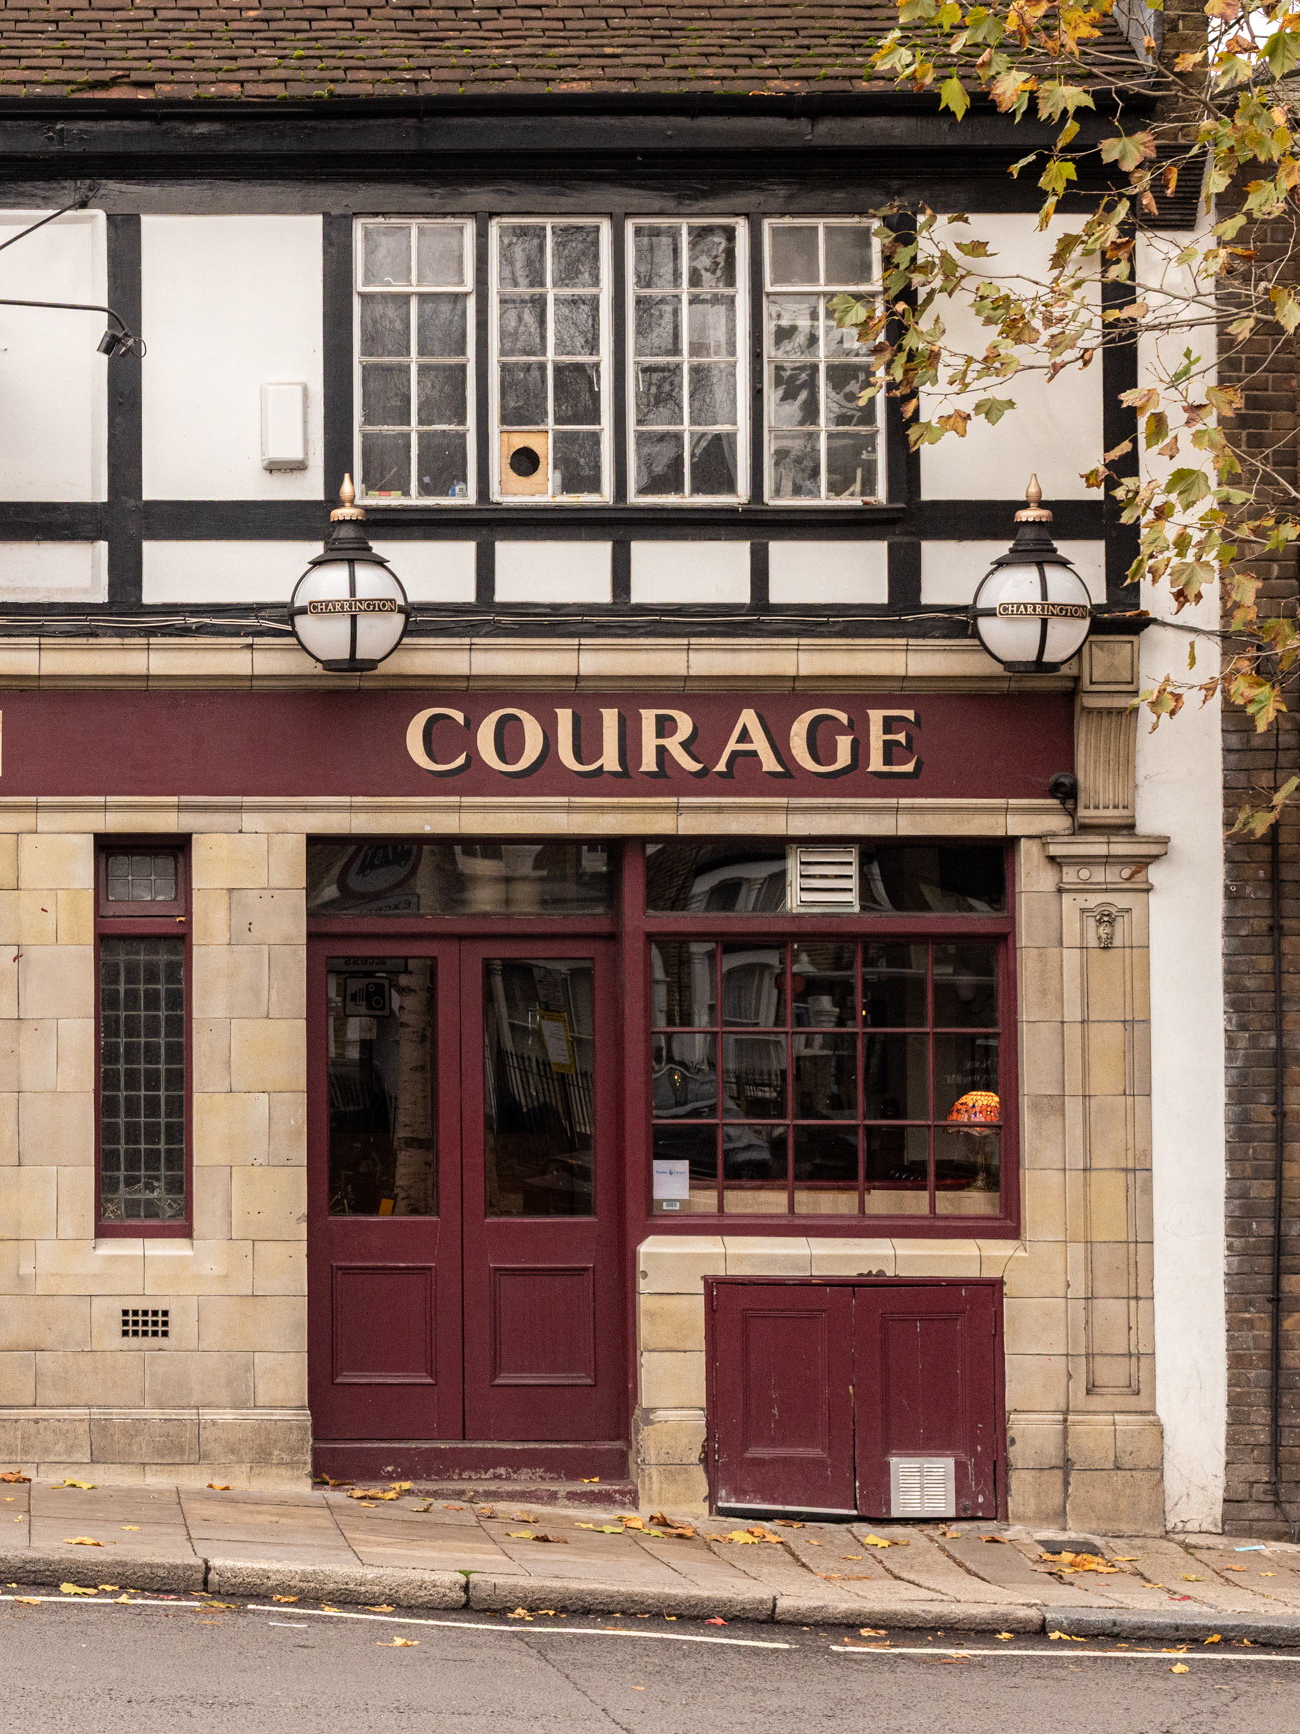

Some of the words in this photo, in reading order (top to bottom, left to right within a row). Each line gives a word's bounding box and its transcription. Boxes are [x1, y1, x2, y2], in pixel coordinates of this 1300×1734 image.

[310, 600, 396, 613] CHARRINGTON
[1000, 604, 1087, 617] CHARRINGTON
[405, 707, 918, 773] COURAGE
